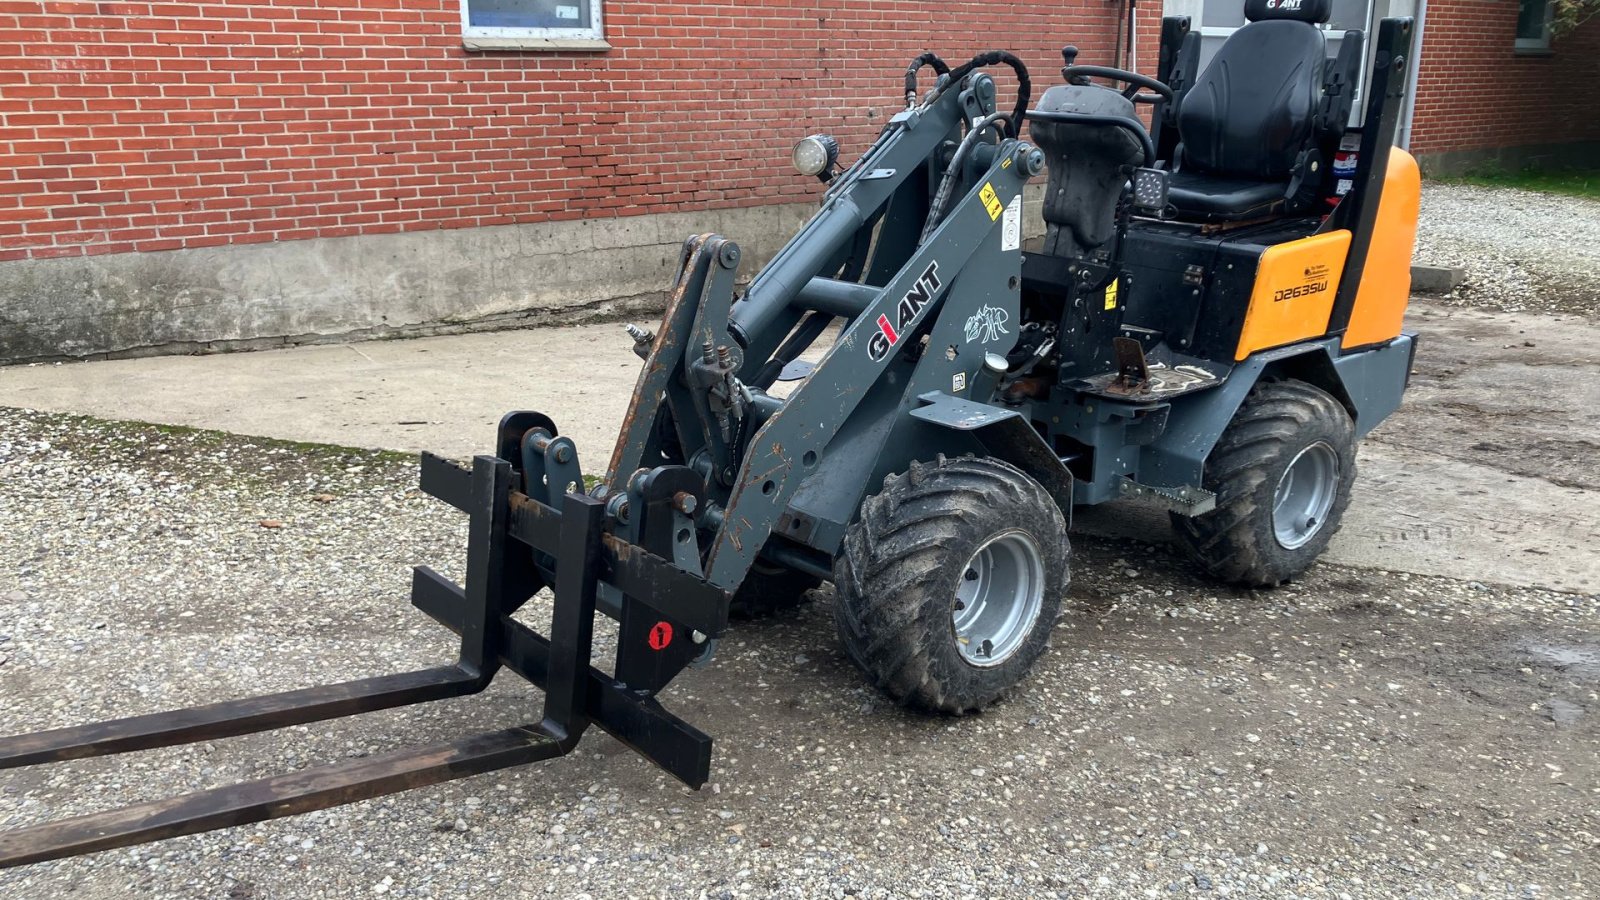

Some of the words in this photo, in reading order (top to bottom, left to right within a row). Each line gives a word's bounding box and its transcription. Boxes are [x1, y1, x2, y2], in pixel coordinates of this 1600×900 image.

[1266, 0, 1301, 8] GIANT
[1273, 279, 1329, 303] D263SW
[867, 259, 942, 363] GIANT
